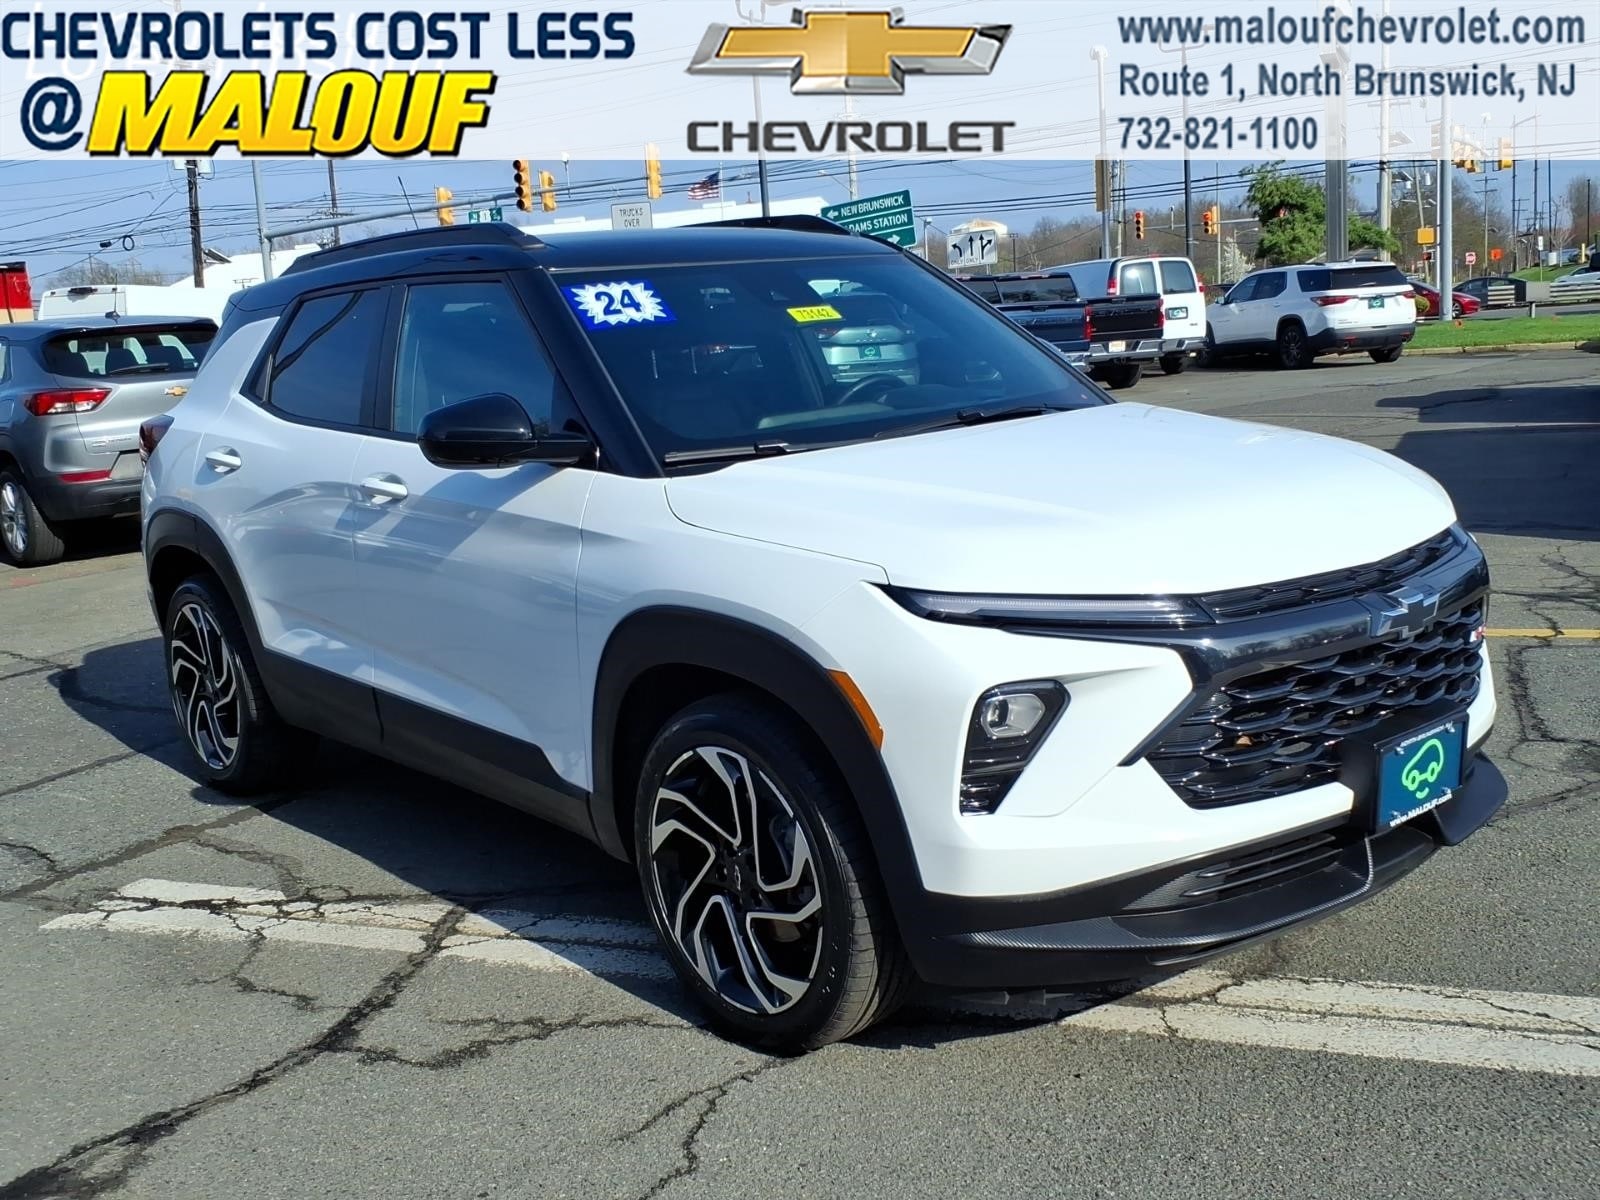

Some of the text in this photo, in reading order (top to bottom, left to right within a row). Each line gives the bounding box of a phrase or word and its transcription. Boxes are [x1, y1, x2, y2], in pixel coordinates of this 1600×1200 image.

[619, 207, 644, 217] TRUCKS
[840, 194, 904, 217] NEW BRUNSWICK
[873, 213, 908, 230] STATION
[594, 288, 643, 316] 24
